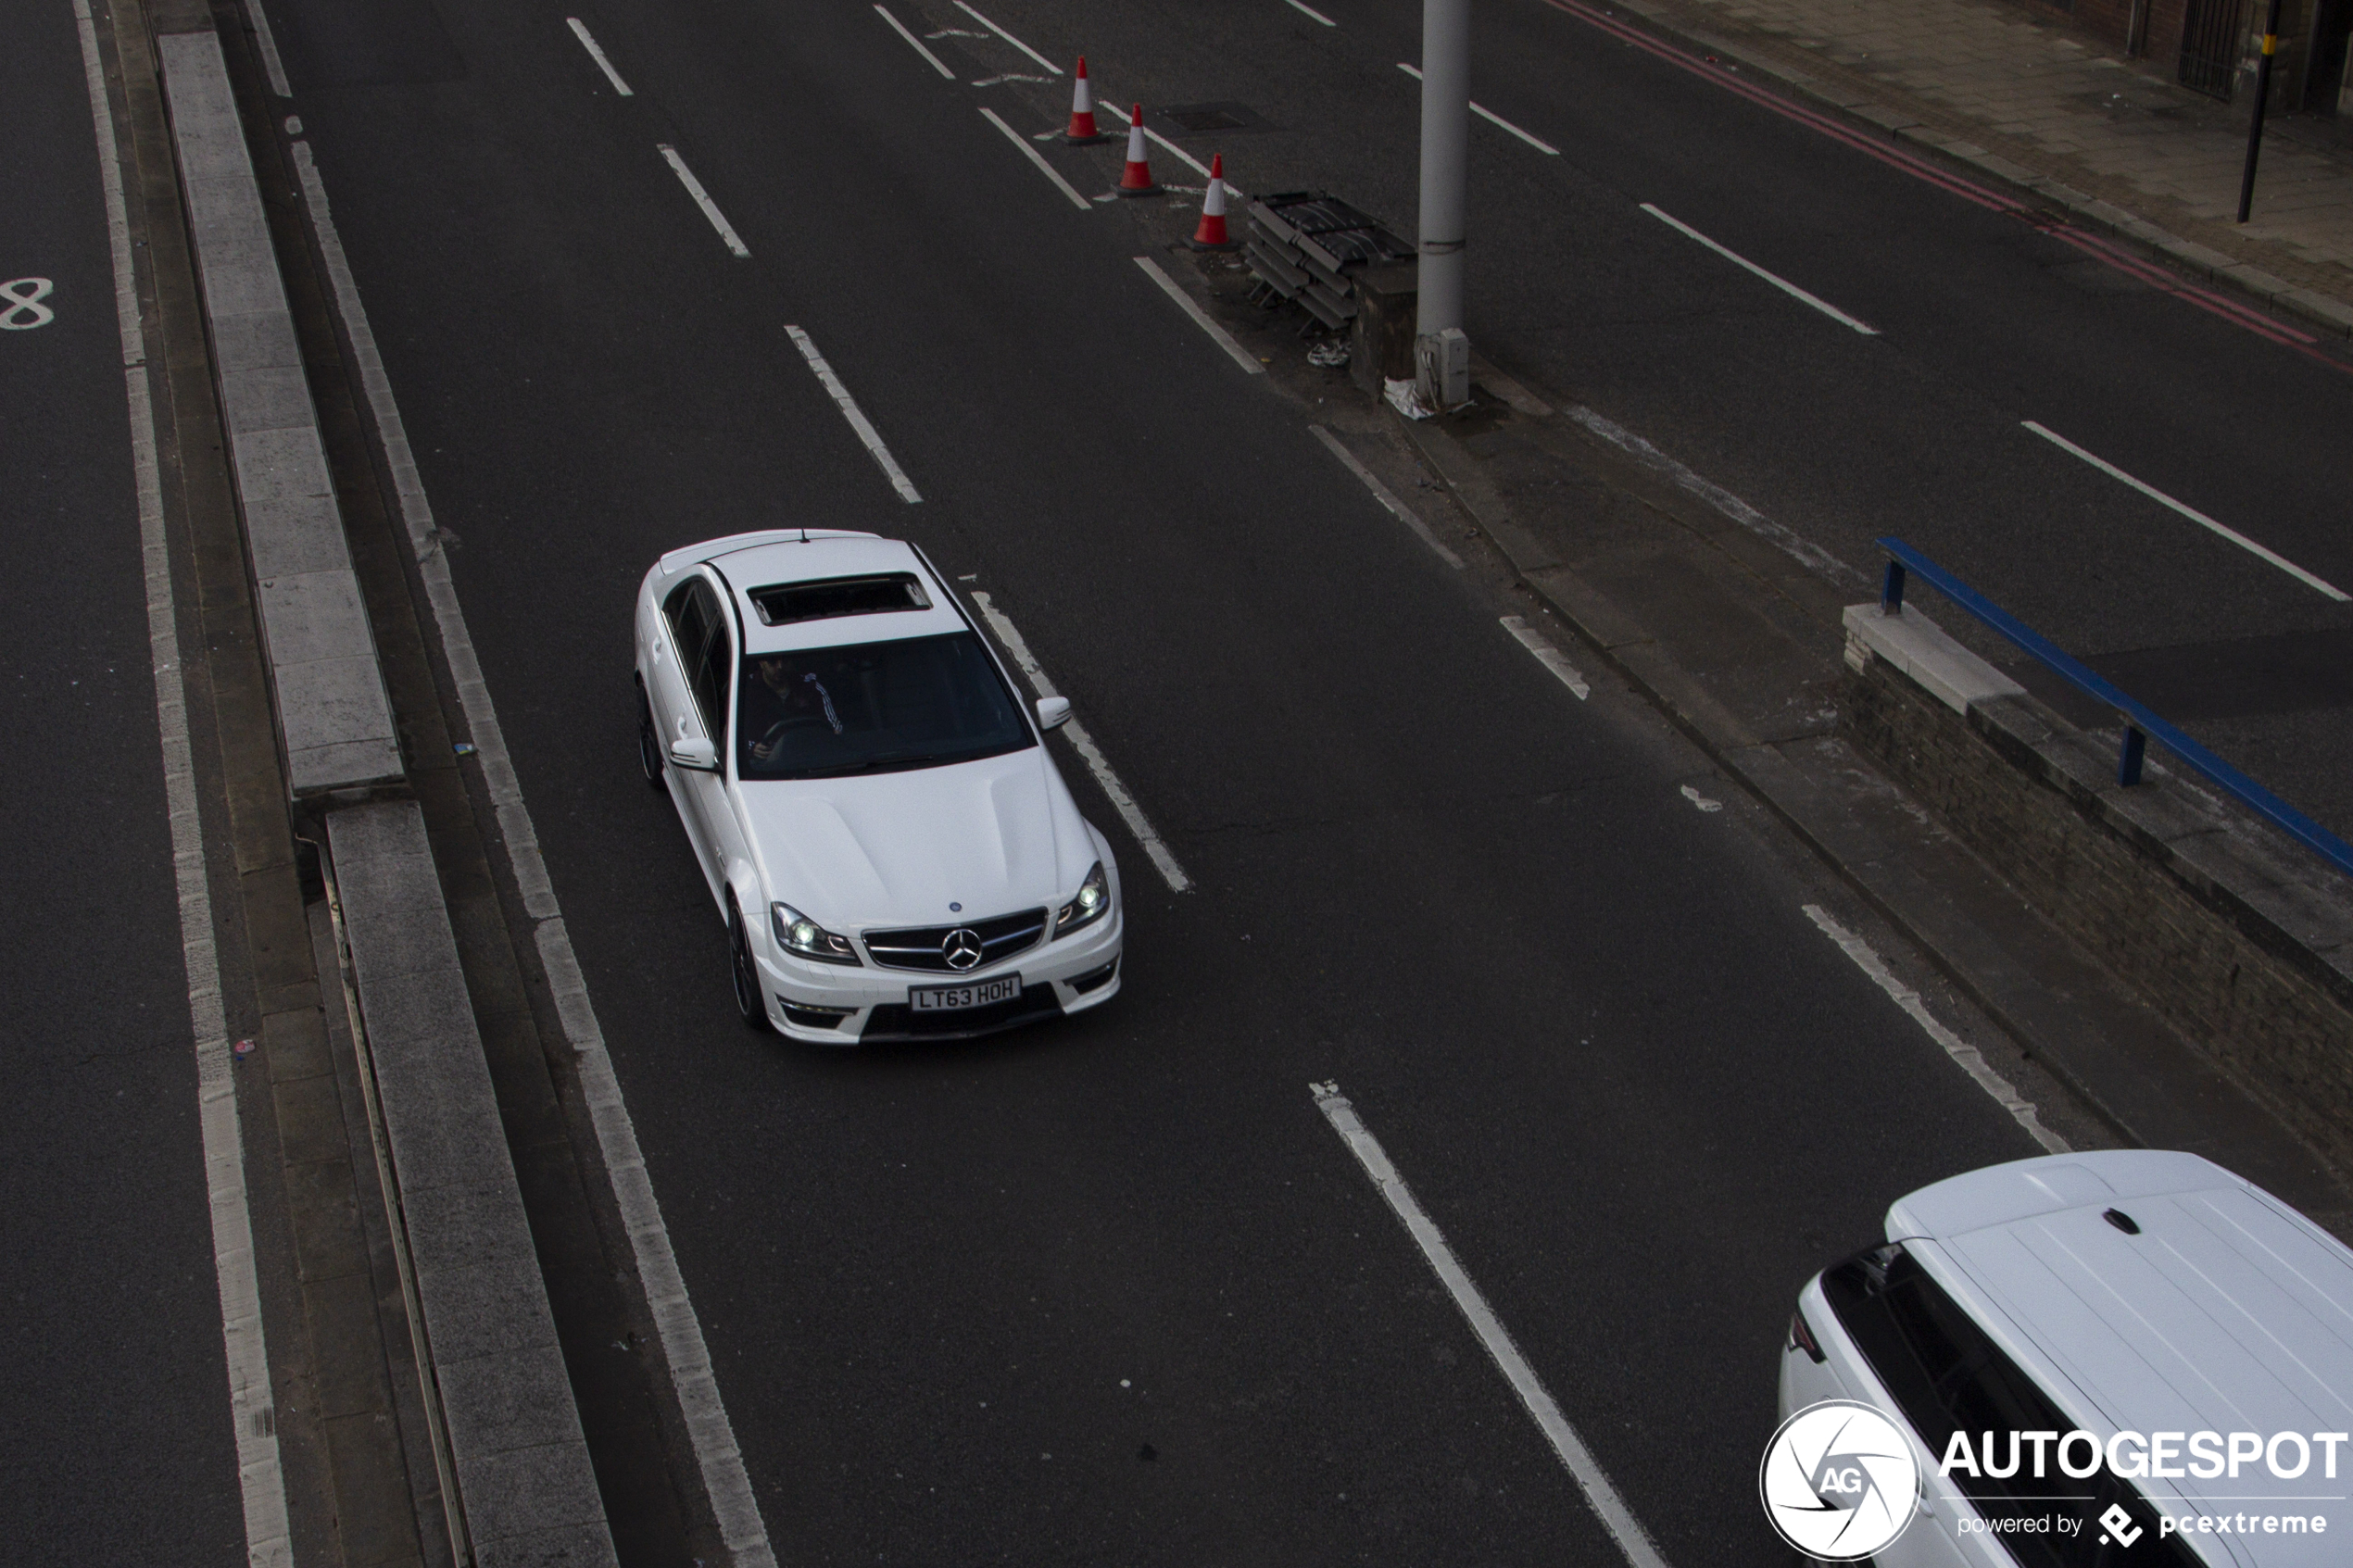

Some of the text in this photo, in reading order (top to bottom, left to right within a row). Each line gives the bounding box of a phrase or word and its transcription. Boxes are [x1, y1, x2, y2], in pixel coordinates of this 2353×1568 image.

[0, 277, 55, 330] 8
[919, 980, 1013, 1008] LT63 HOH
